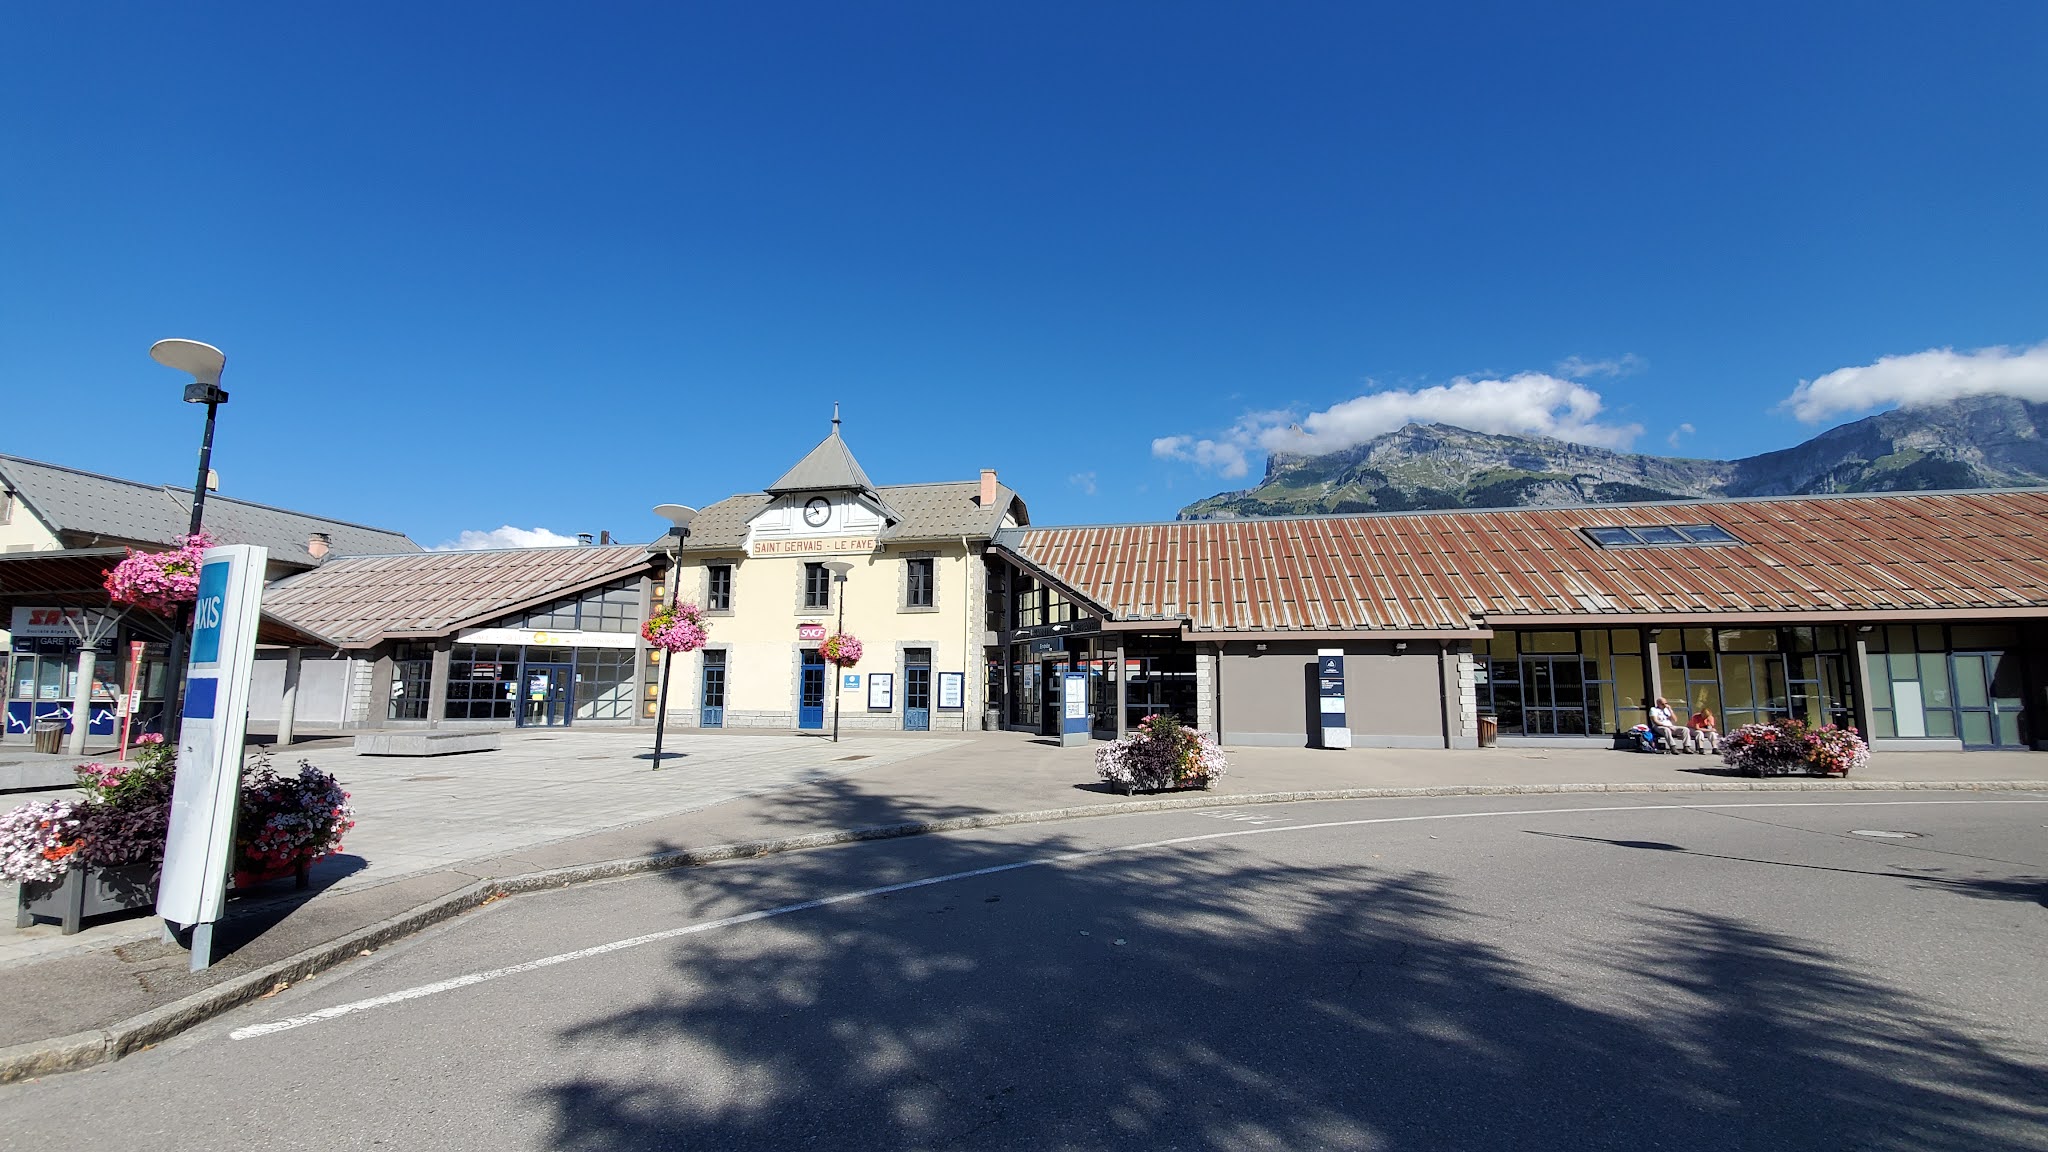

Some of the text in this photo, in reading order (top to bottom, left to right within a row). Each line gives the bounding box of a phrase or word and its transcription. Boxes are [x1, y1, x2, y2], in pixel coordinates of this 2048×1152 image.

[754, 542, 781, 553] SAINT
[784, 540, 823, 552] GERVAIS
[834, 540, 847, 550] LE
[800, 628, 826, 637] SNCF
[40, 637, 65, 646] GARE
